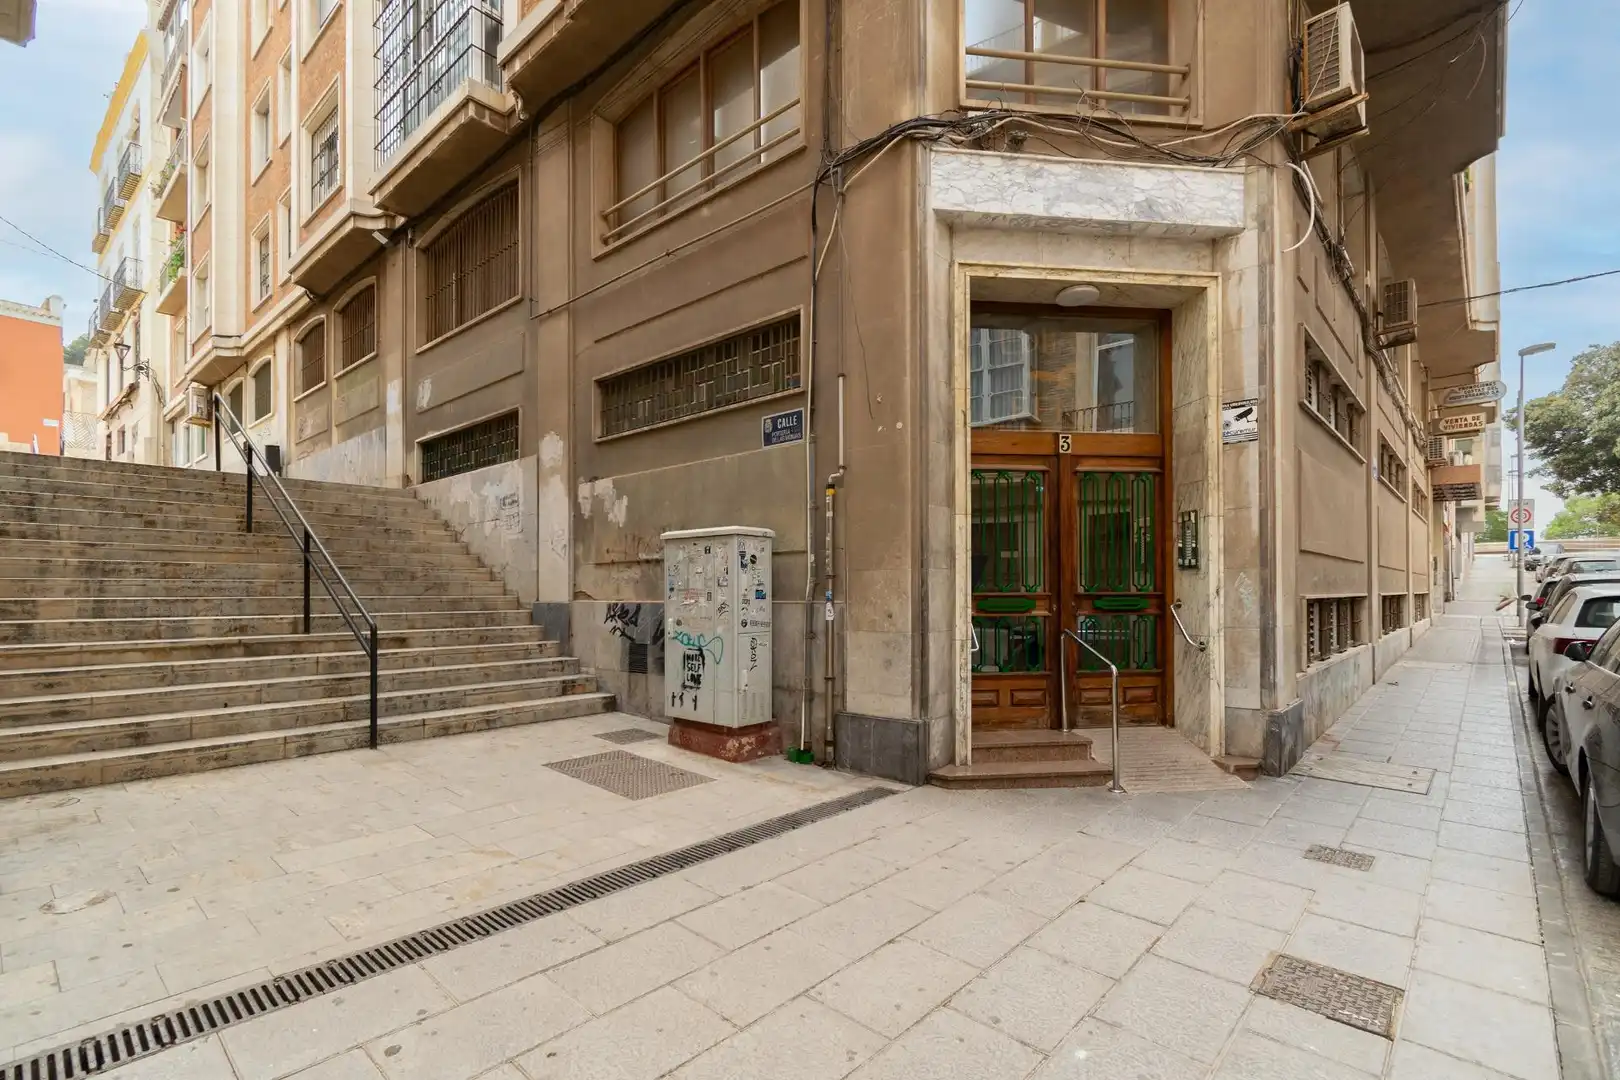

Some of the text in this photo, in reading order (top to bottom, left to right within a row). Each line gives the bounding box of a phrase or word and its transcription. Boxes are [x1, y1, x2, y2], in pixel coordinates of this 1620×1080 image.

[777, 415, 797, 429] CALLE
[1443, 421, 1484, 430] VIVIENDAS
[1060, 436, 1070, 452] 3
[686, 653, 701, 662] MORE
[686, 662, 701, 673] SELF
